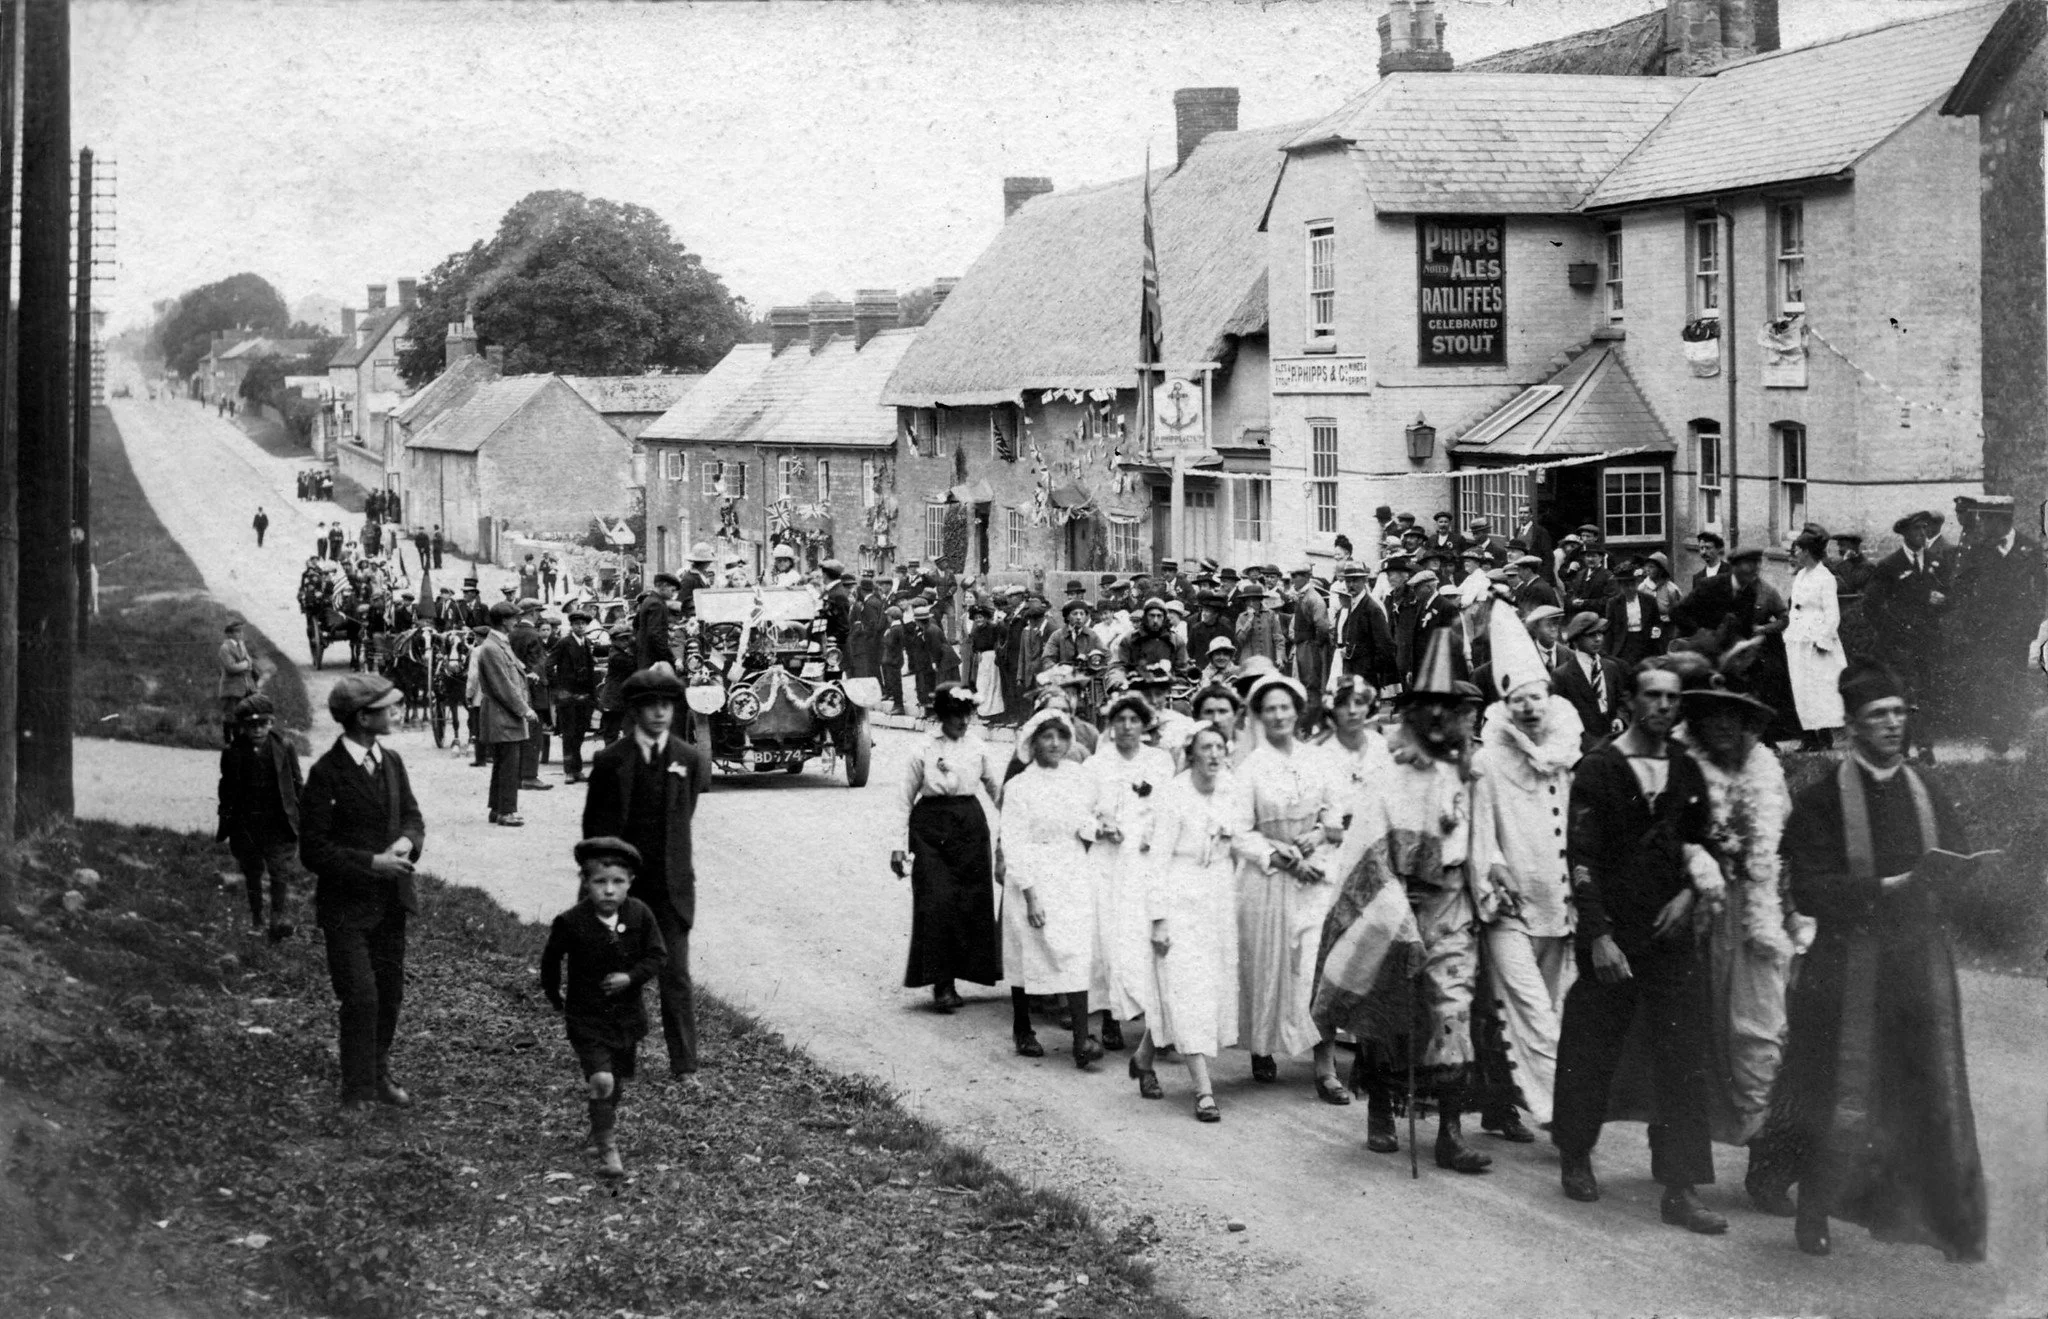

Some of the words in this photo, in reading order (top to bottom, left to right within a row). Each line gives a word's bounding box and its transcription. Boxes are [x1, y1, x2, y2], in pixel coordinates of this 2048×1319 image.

[1425, 223, 1499, 263] PHIPPS
[1423, 264, 1449, 274] NOTED
[1450, 255, 1501, 279] ALES
[1422, 283, 1502, 313] RATLIFFE'S
[1428, 318, 1498, 330] CELEBRATED
[1432, 334, 1494, 354] STOUT
[1330, 365, 1337, 382] &
[754, 751, 773, 763] BD
